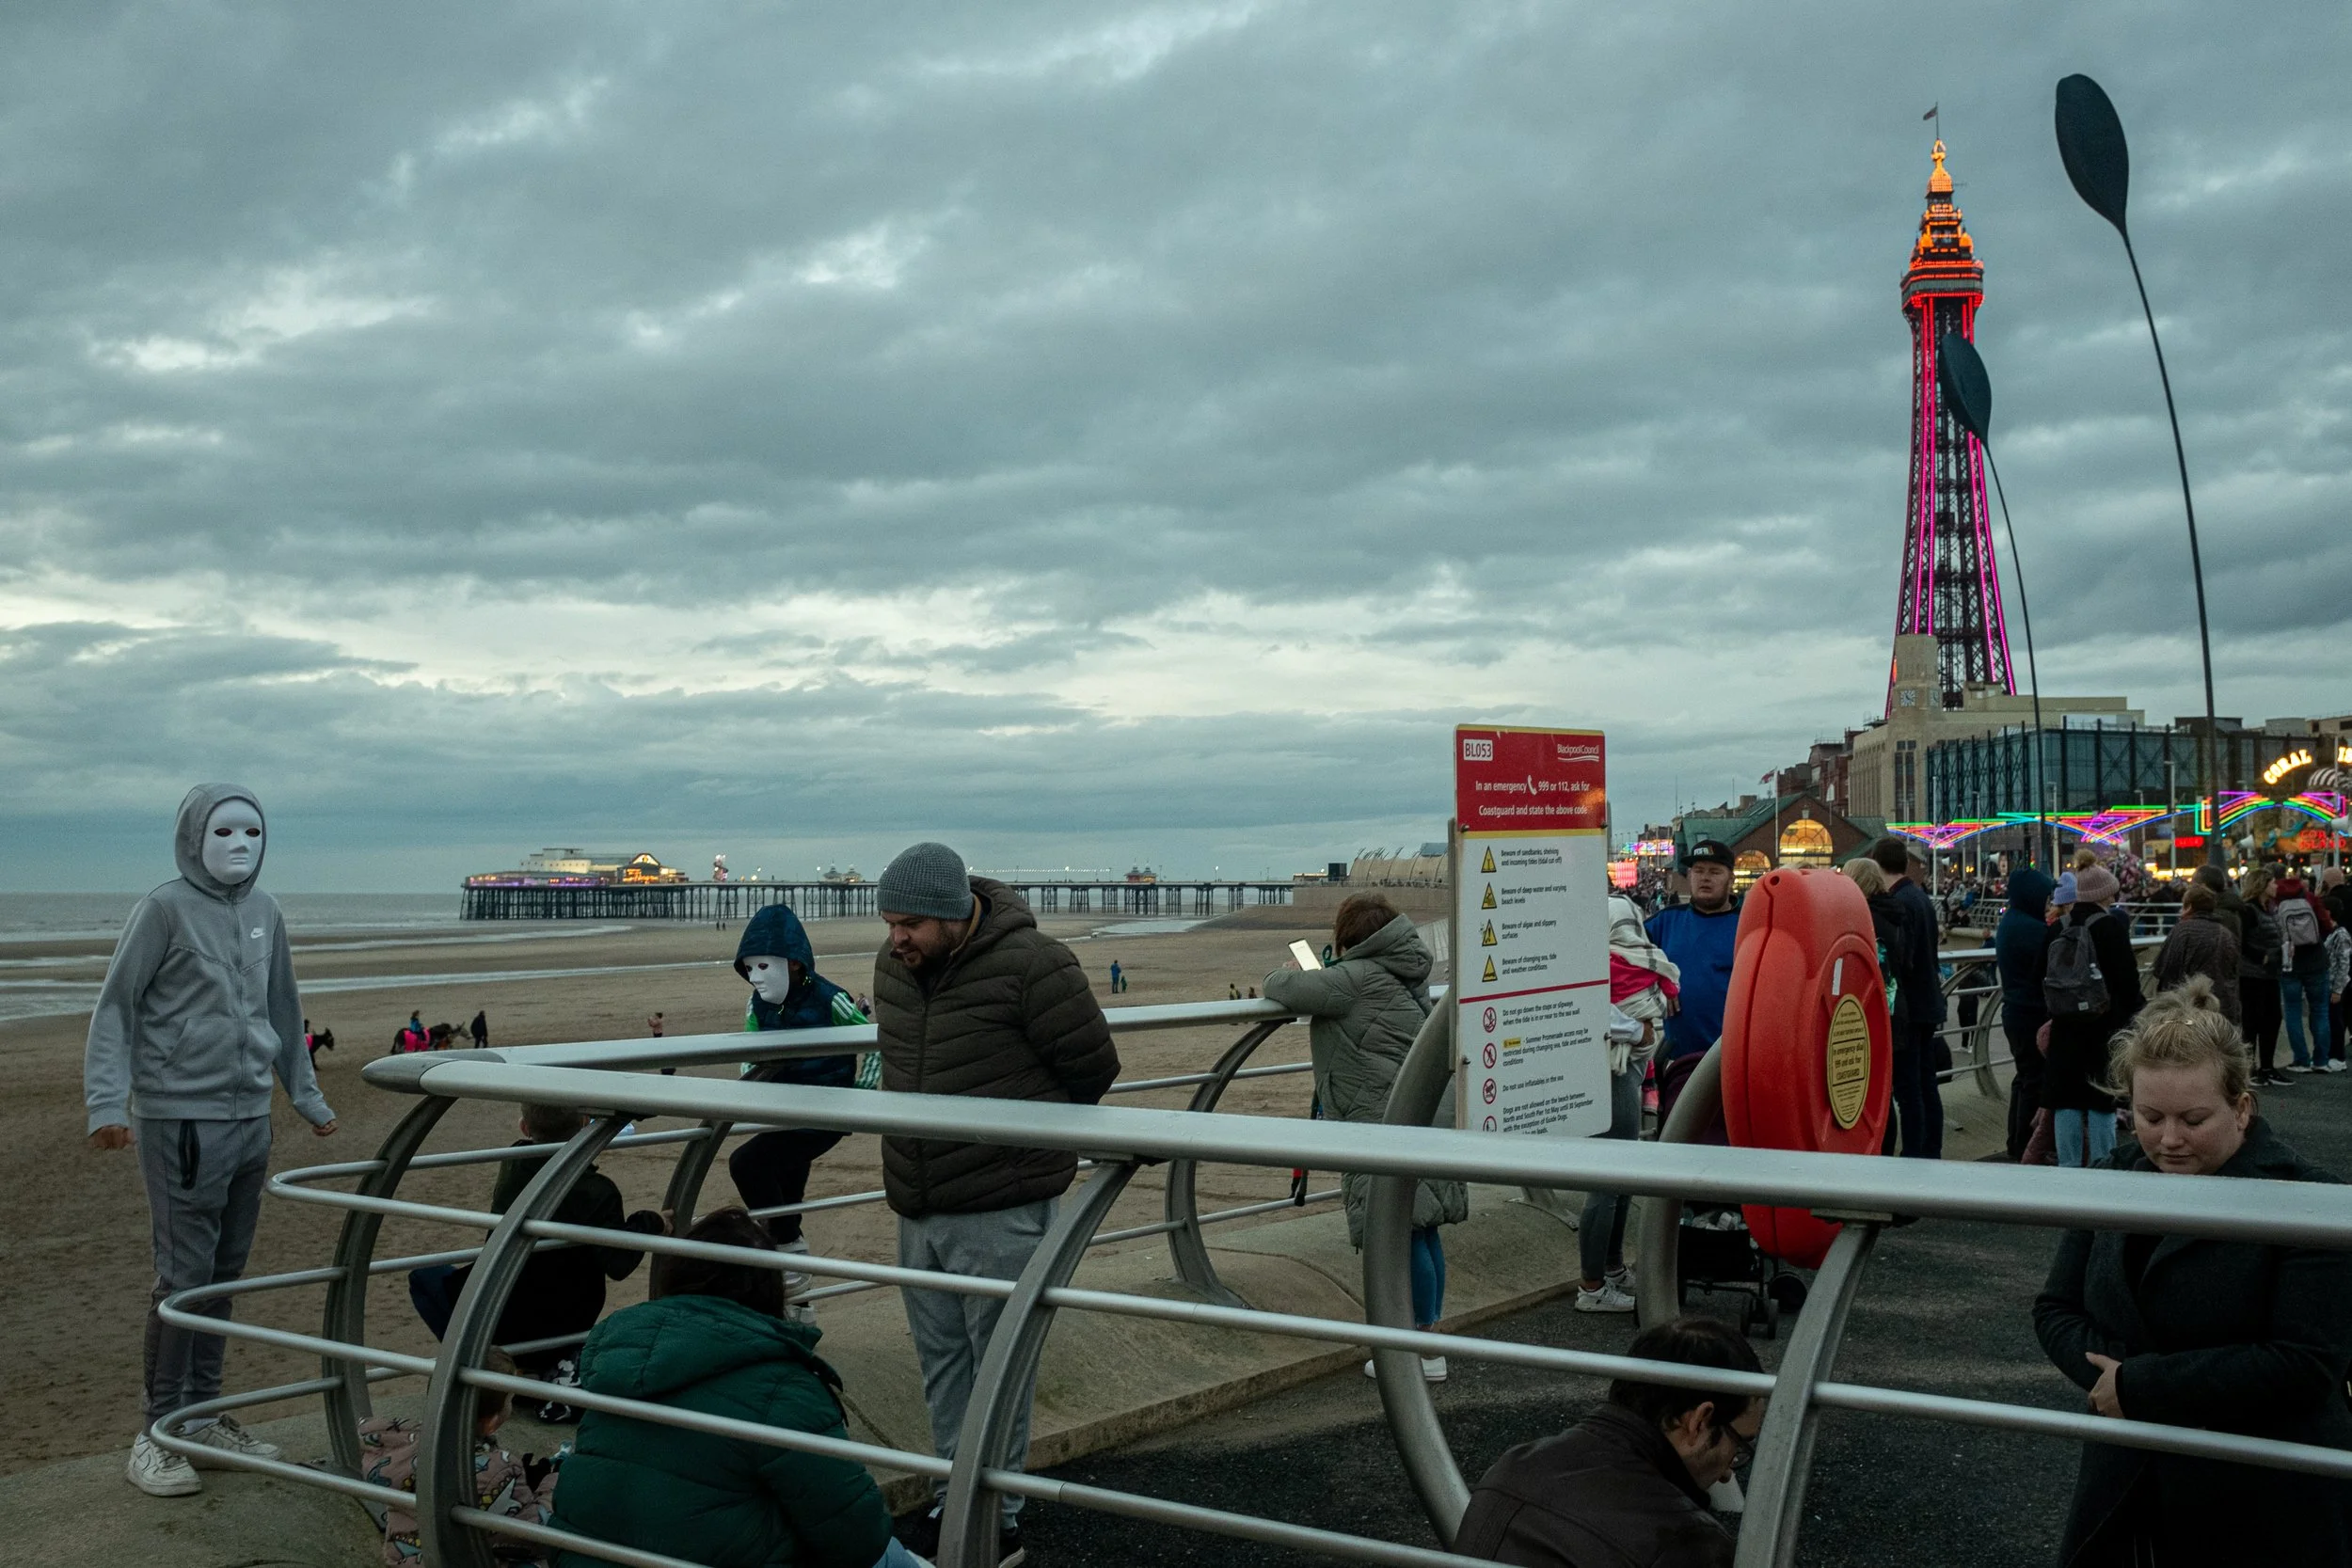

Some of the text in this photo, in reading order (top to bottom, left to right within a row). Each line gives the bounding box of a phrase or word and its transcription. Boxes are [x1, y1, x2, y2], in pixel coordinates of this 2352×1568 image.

[1465, 743, 1492, 758] BL053
[2263, 749, 2312, 784] CORAL
[1476, 781, 1482, 790] In
[1493, 782, 1527, 794] emergency
[1538, 781, 1549, 791] 999
[1571, 781, 1580, 791] ask
[1581, 781, 1589, 791] for
[1479, 805, 1588, 818] Coastguard and state the above code
[1503, 1049, 1522, 1057] restricted
[1536, 1044, 1553, 1052] changing
[1503, 1058, 1524, 1067] conditions
[1525, 1079, 1545, 1088] inflatables
[1529, 1100, 1545, 1108] allowed
[1574, 1099, 1593, 1109] September
[1521, 1120, 1540, 1129] exception
